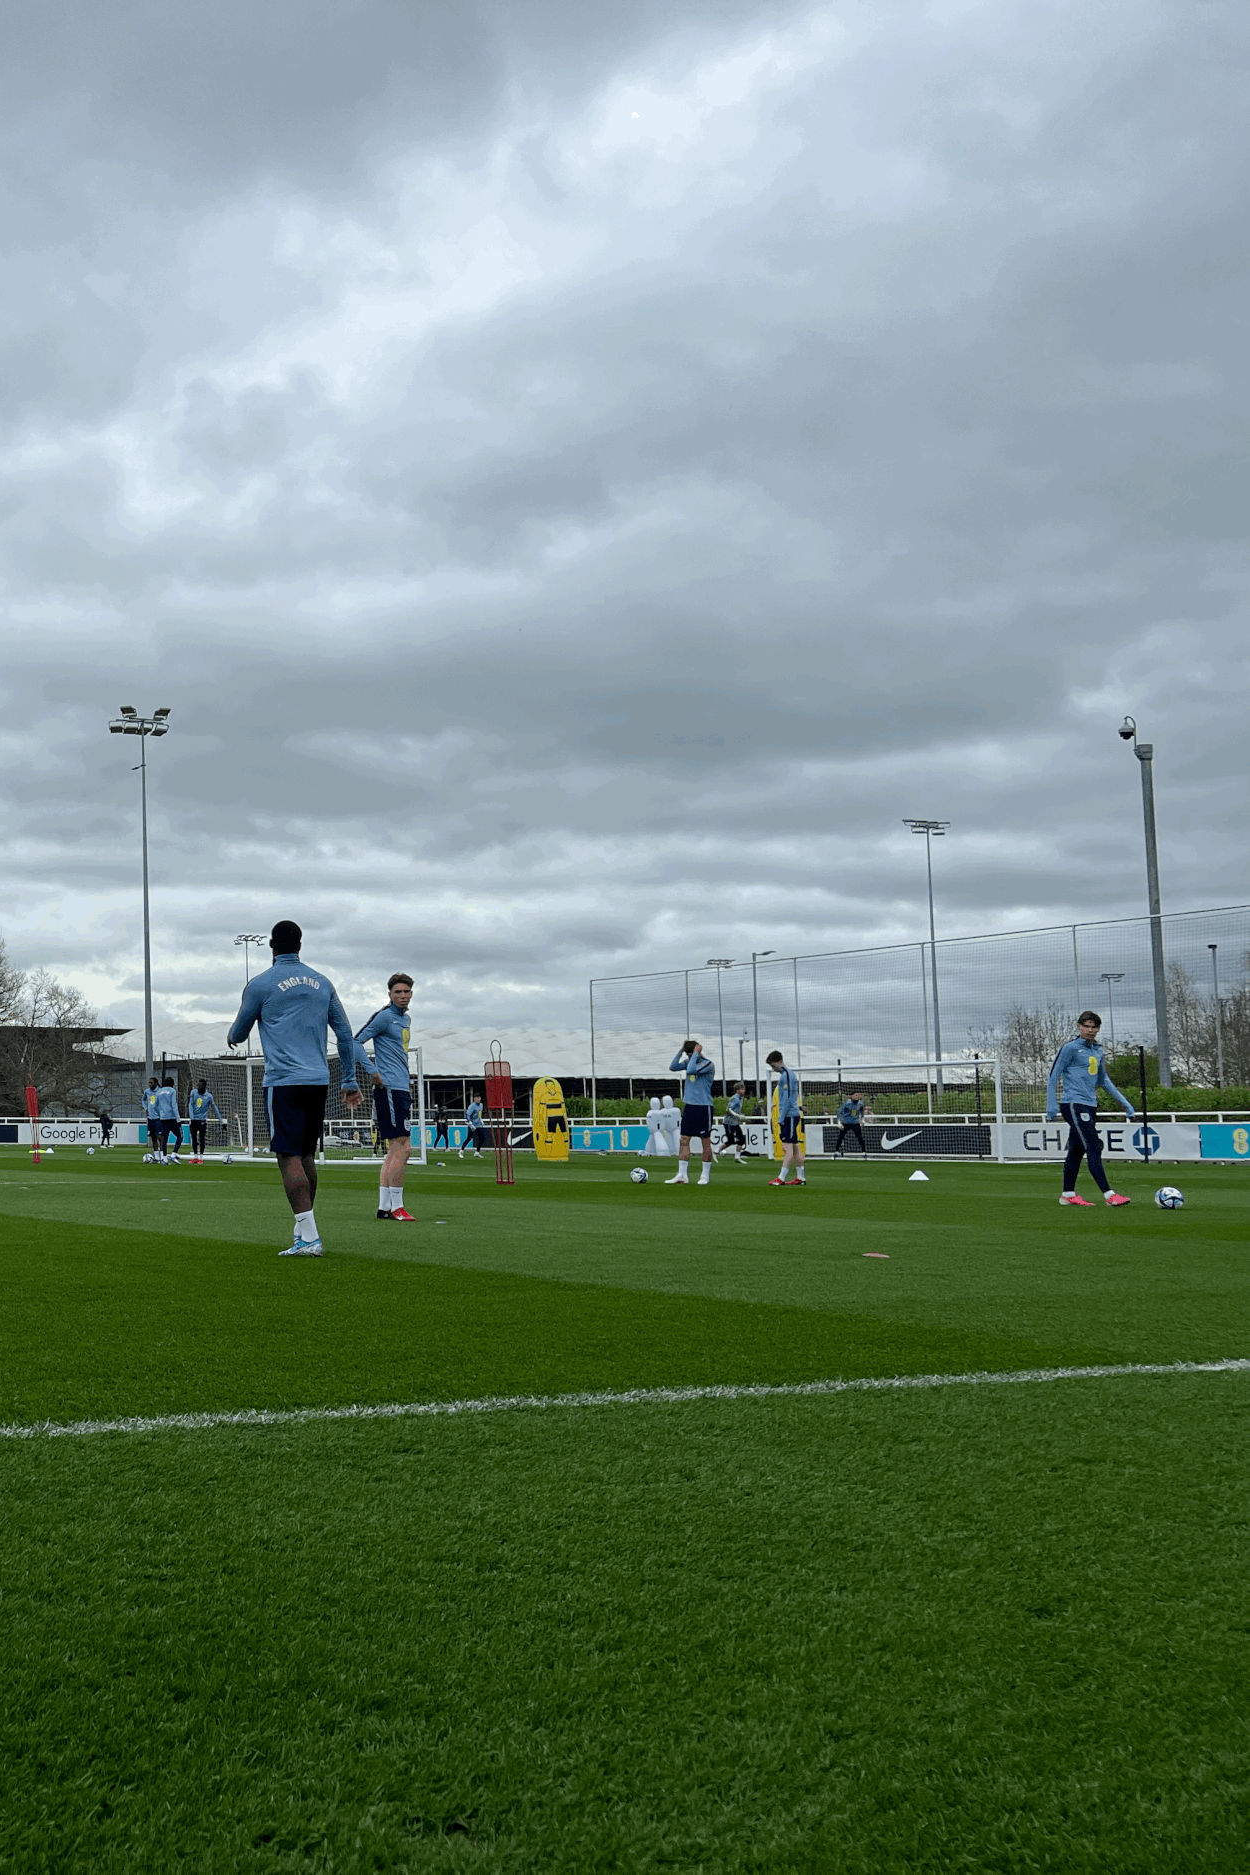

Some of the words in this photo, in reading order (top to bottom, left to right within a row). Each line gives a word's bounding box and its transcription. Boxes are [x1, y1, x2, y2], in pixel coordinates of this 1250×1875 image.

[278, 976, 320, 992] ENGLAND
[40, 1126, 86, 1142] Google
[1022, 1130, 1125, 1152] CHE
